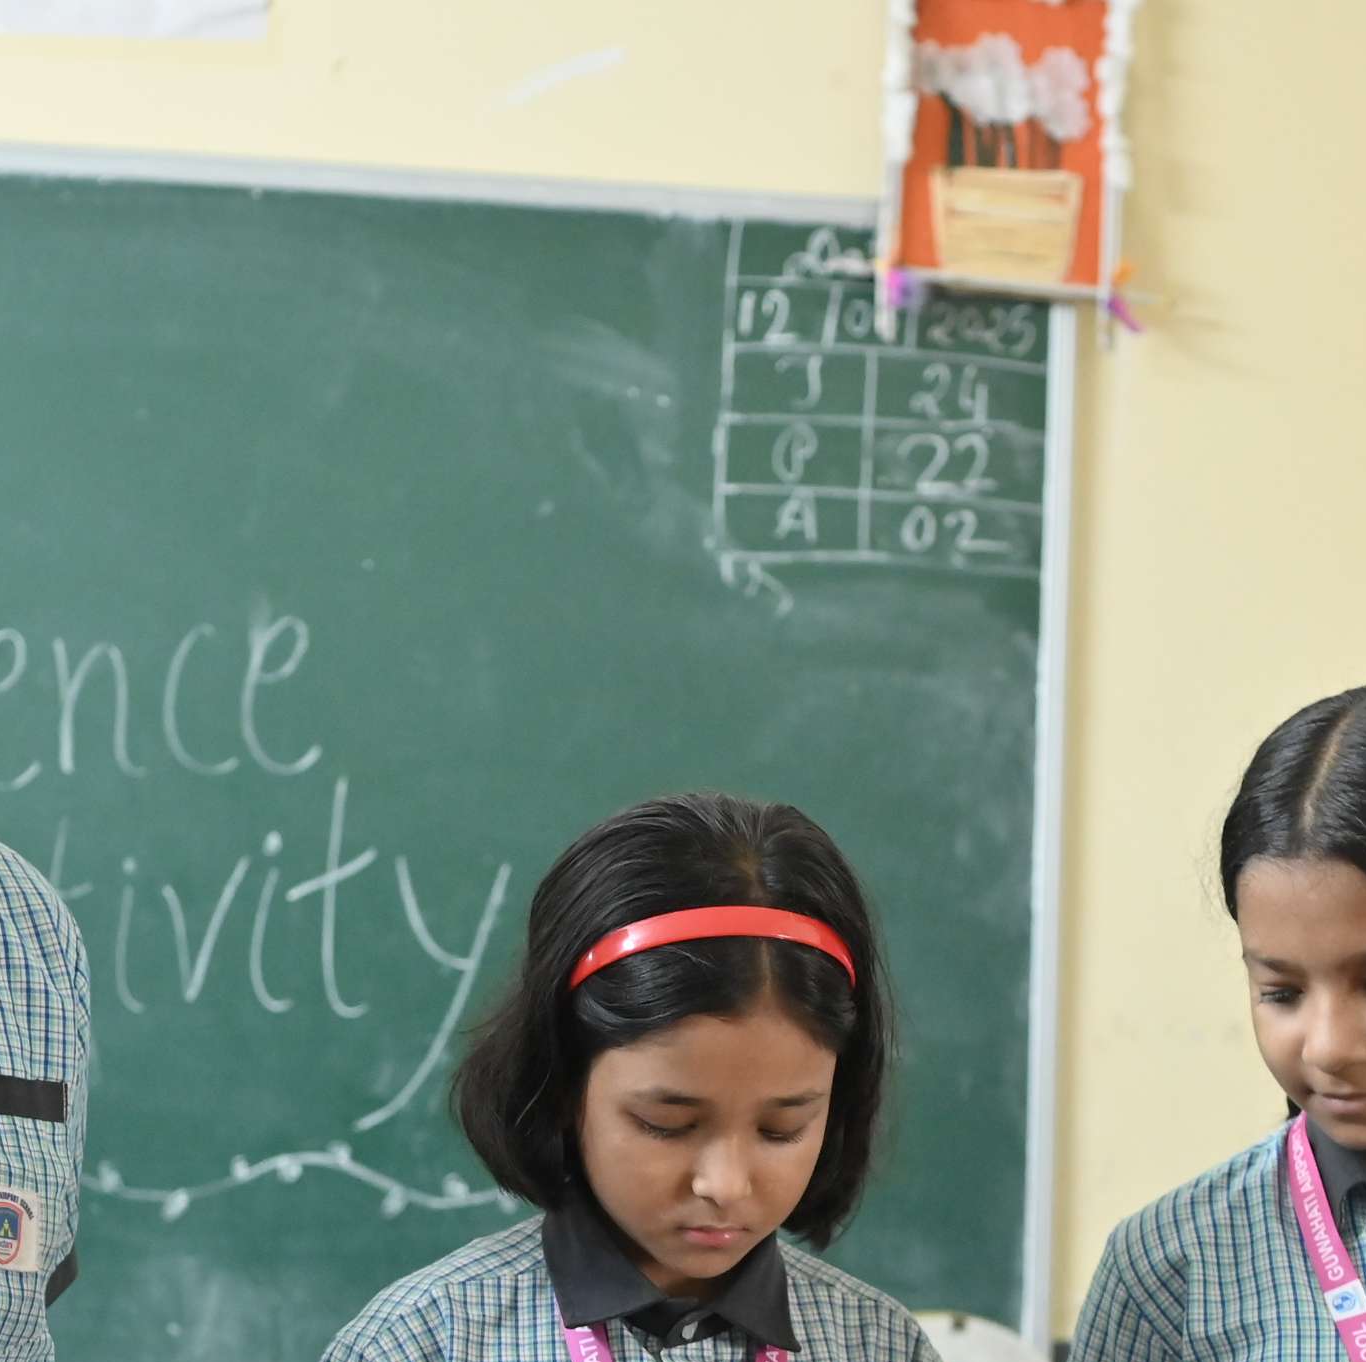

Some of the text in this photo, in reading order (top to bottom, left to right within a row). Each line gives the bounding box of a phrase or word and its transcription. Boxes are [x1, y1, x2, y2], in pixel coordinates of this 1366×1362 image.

[897, 432, 998, 496] 22
[1291, 1128, 1345, 1282] GUWAHATI AIRPORT
